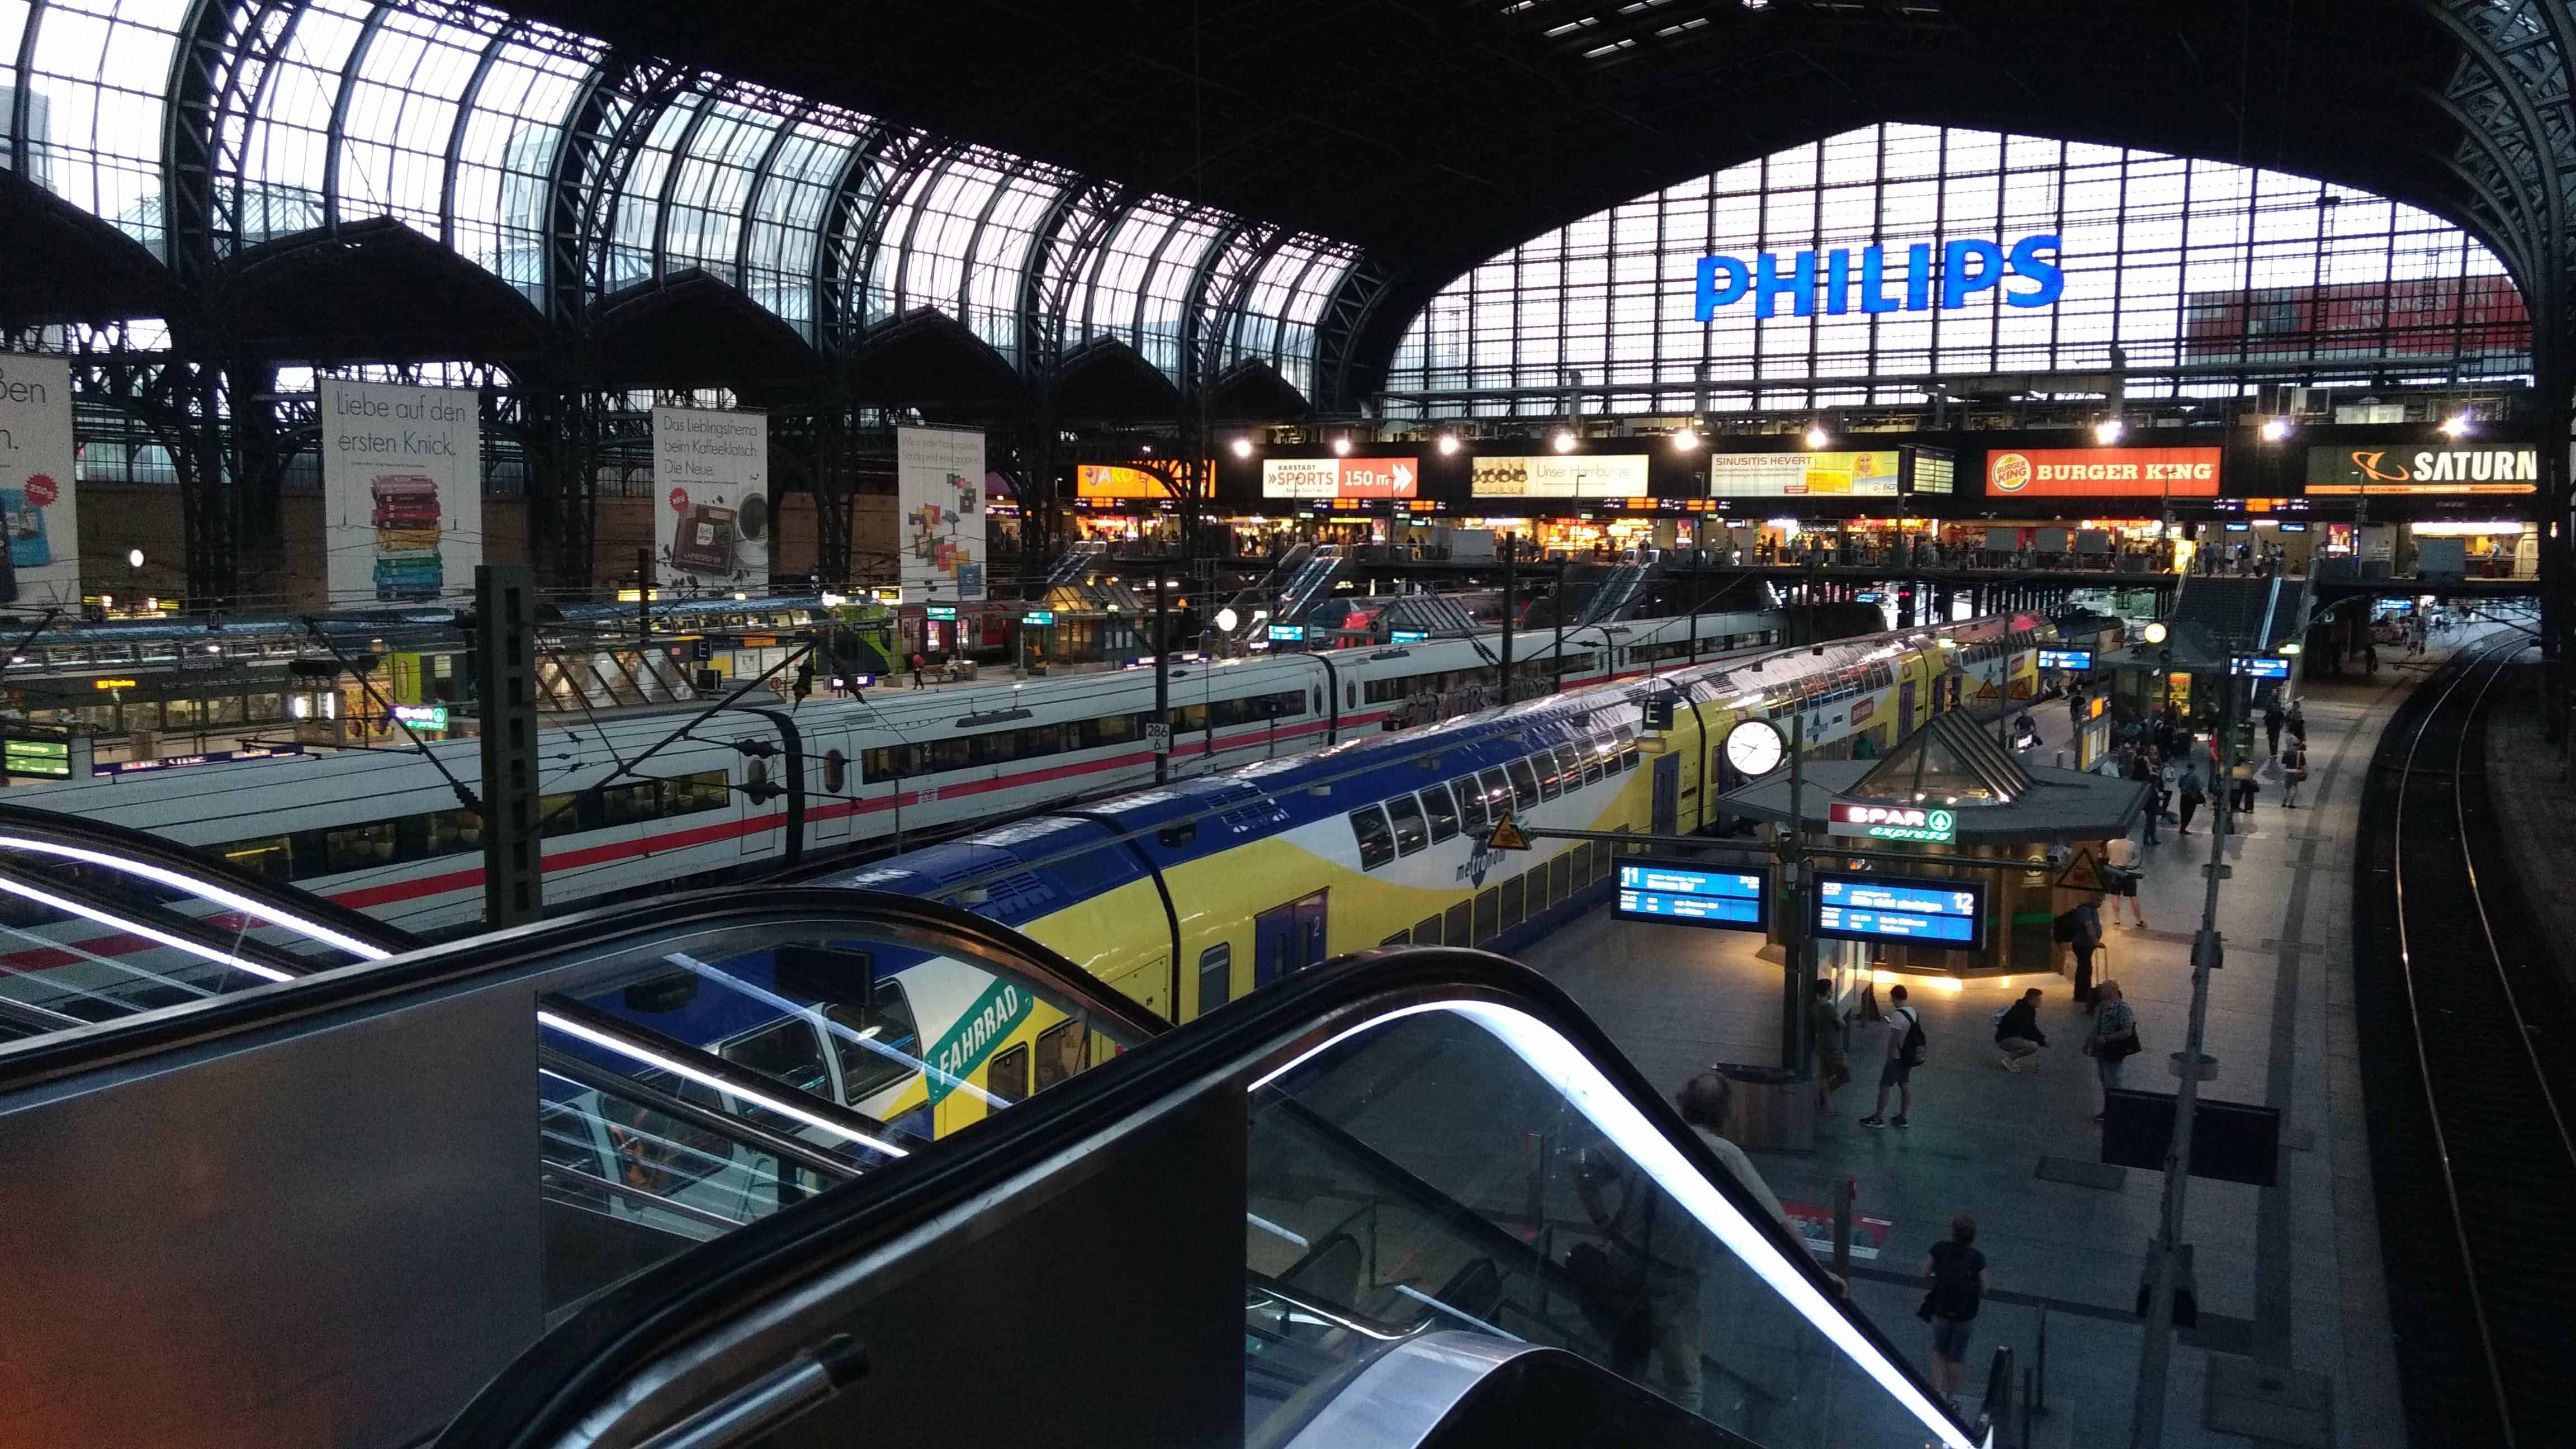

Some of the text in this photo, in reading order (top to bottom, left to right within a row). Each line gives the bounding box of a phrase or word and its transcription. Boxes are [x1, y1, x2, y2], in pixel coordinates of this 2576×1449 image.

[1695, 234, 2064, 322] PHILIPS
[337, 390, 466, 422] Liebe auf den
[664, 415, 757, 439] Das Lieblingsthema
[339, 430, 457, 456] ersten Knick.
[664, 438, 689, 452] beim
[664, 458, 716, 476] Die Neue.
[1715, 456, 1813, 466] SINUSITIS HEVERT
[1997, 460, 2026, 474] BURGER
[2413, 451, 2537, 481] SATURN
[1277, 472, 1334, 485] SPORTS
[1344, 471, 1391, 486] 150 m
[1537, 465, 1567, 477] Unser
[1998, 468, 2027, 483] KING
[2037, 463, 2212, 480] BURGER KING
[1646, 702, 1661, 723] E
[1147, 724, 1168, 737] 286
[924, 744, 930, 756] 2
[1154, 738, 1161, 750] 6
[662, 780, 671, 795] 2
[1849, 806, 1925, 826] SPAR
[1869, 827, 1951, 841] express
[1456, 850, 1506, 882] metronom
[1622, 866, 1639, 883] 11
[1953, 892, 1974, 910] 12
[1313, 916, 1320, 937] 2
[939, 984, 1019, 1086] FAHRRAD
